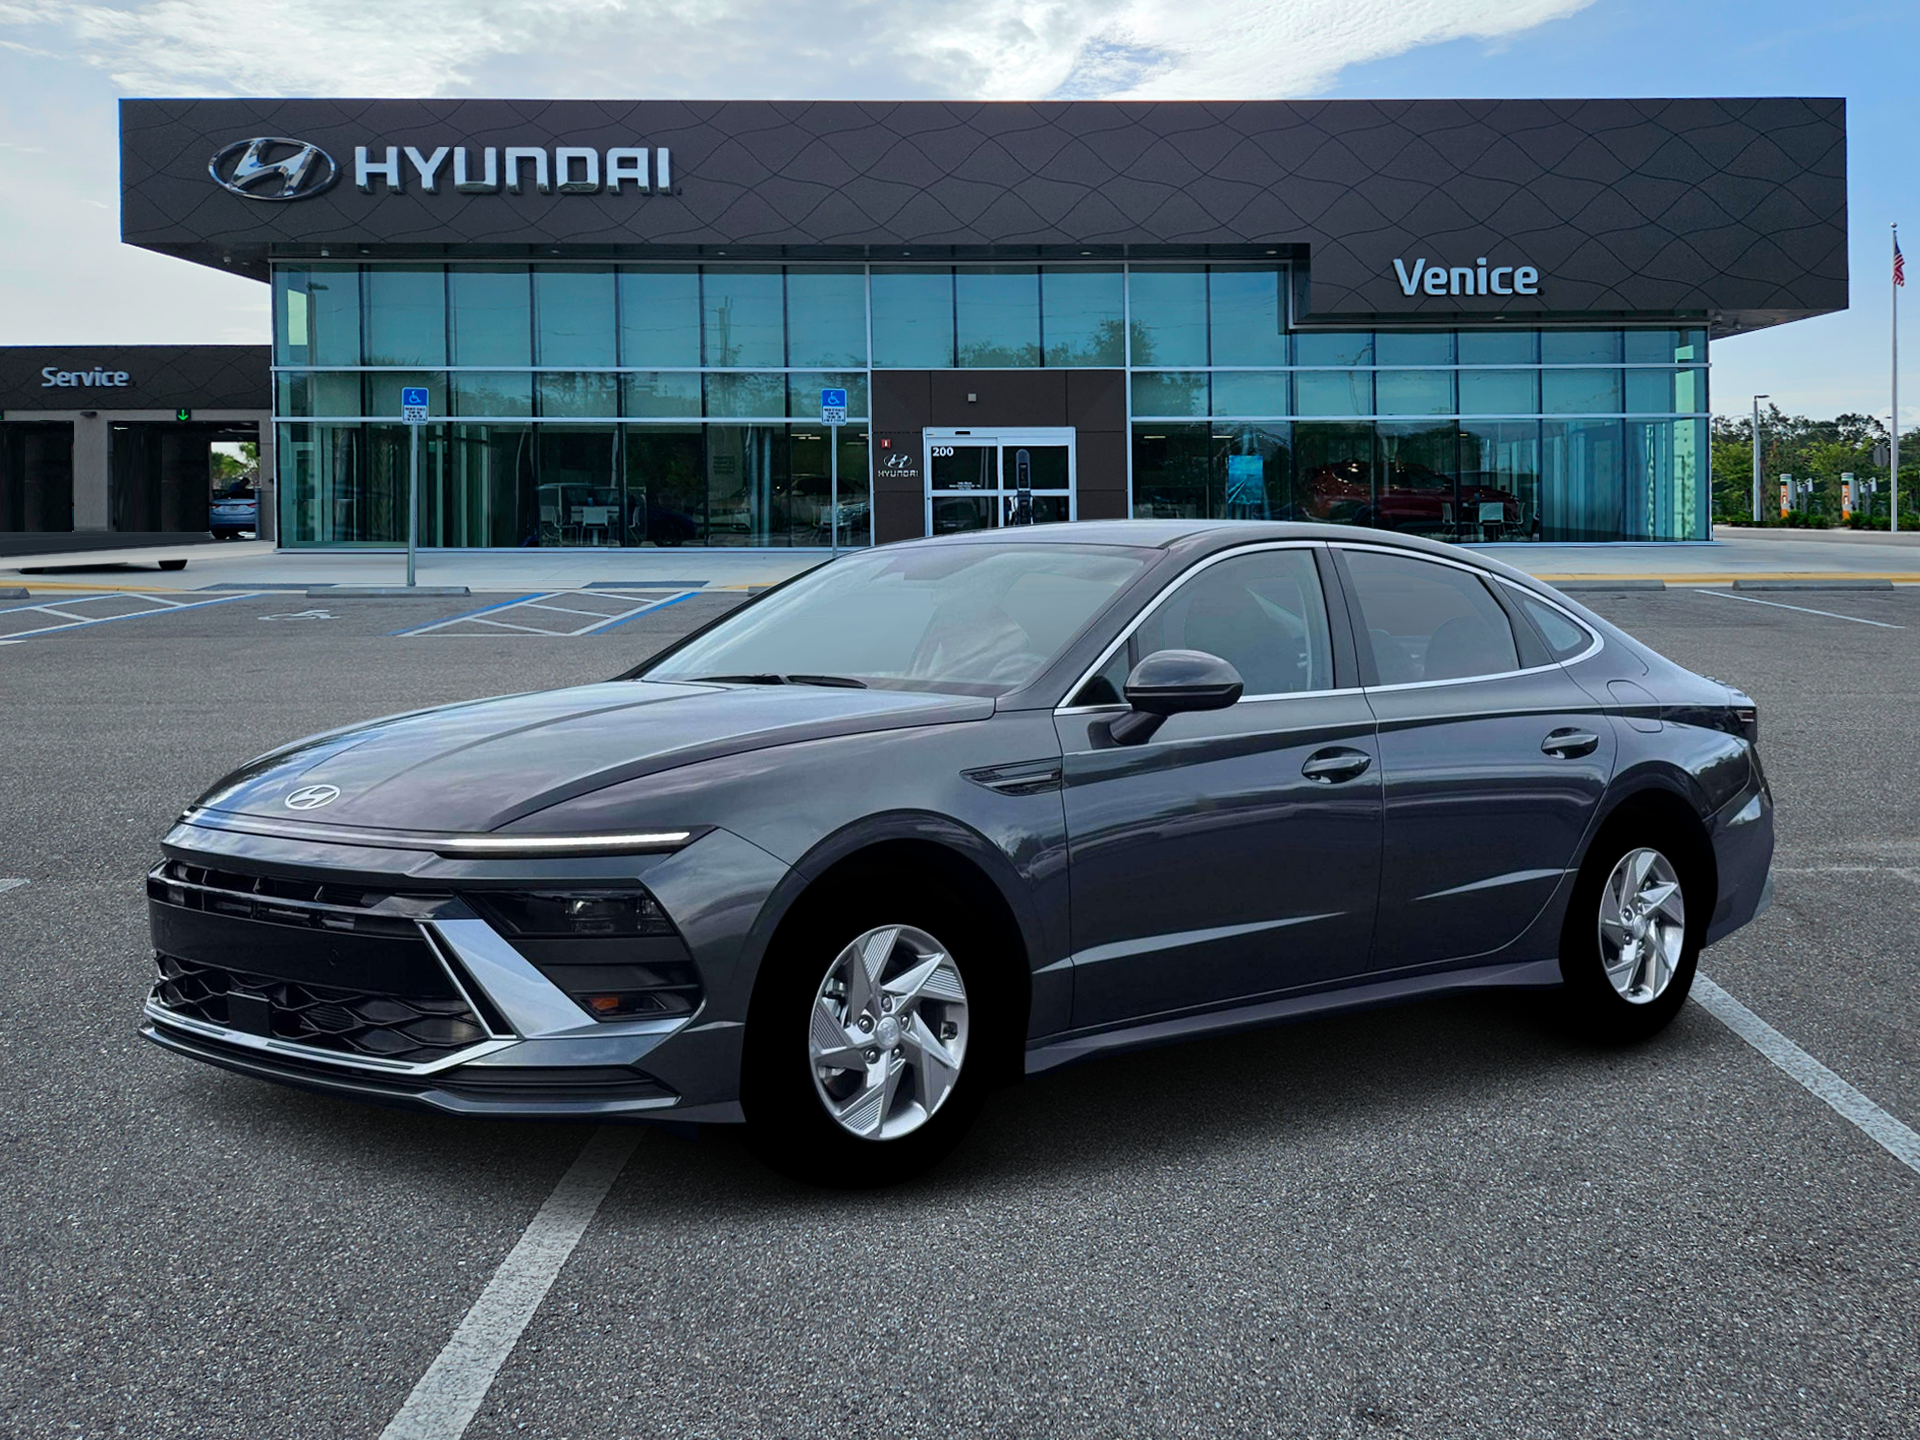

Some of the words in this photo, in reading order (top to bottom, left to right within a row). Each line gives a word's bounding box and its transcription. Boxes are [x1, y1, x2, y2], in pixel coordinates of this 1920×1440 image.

[354, 146, 671, 192] HYUNDAI
[1393, 257, 1539, 295] Venice
[41, 367, 130, 387] Service
[932, 447, 954, 457] 200
